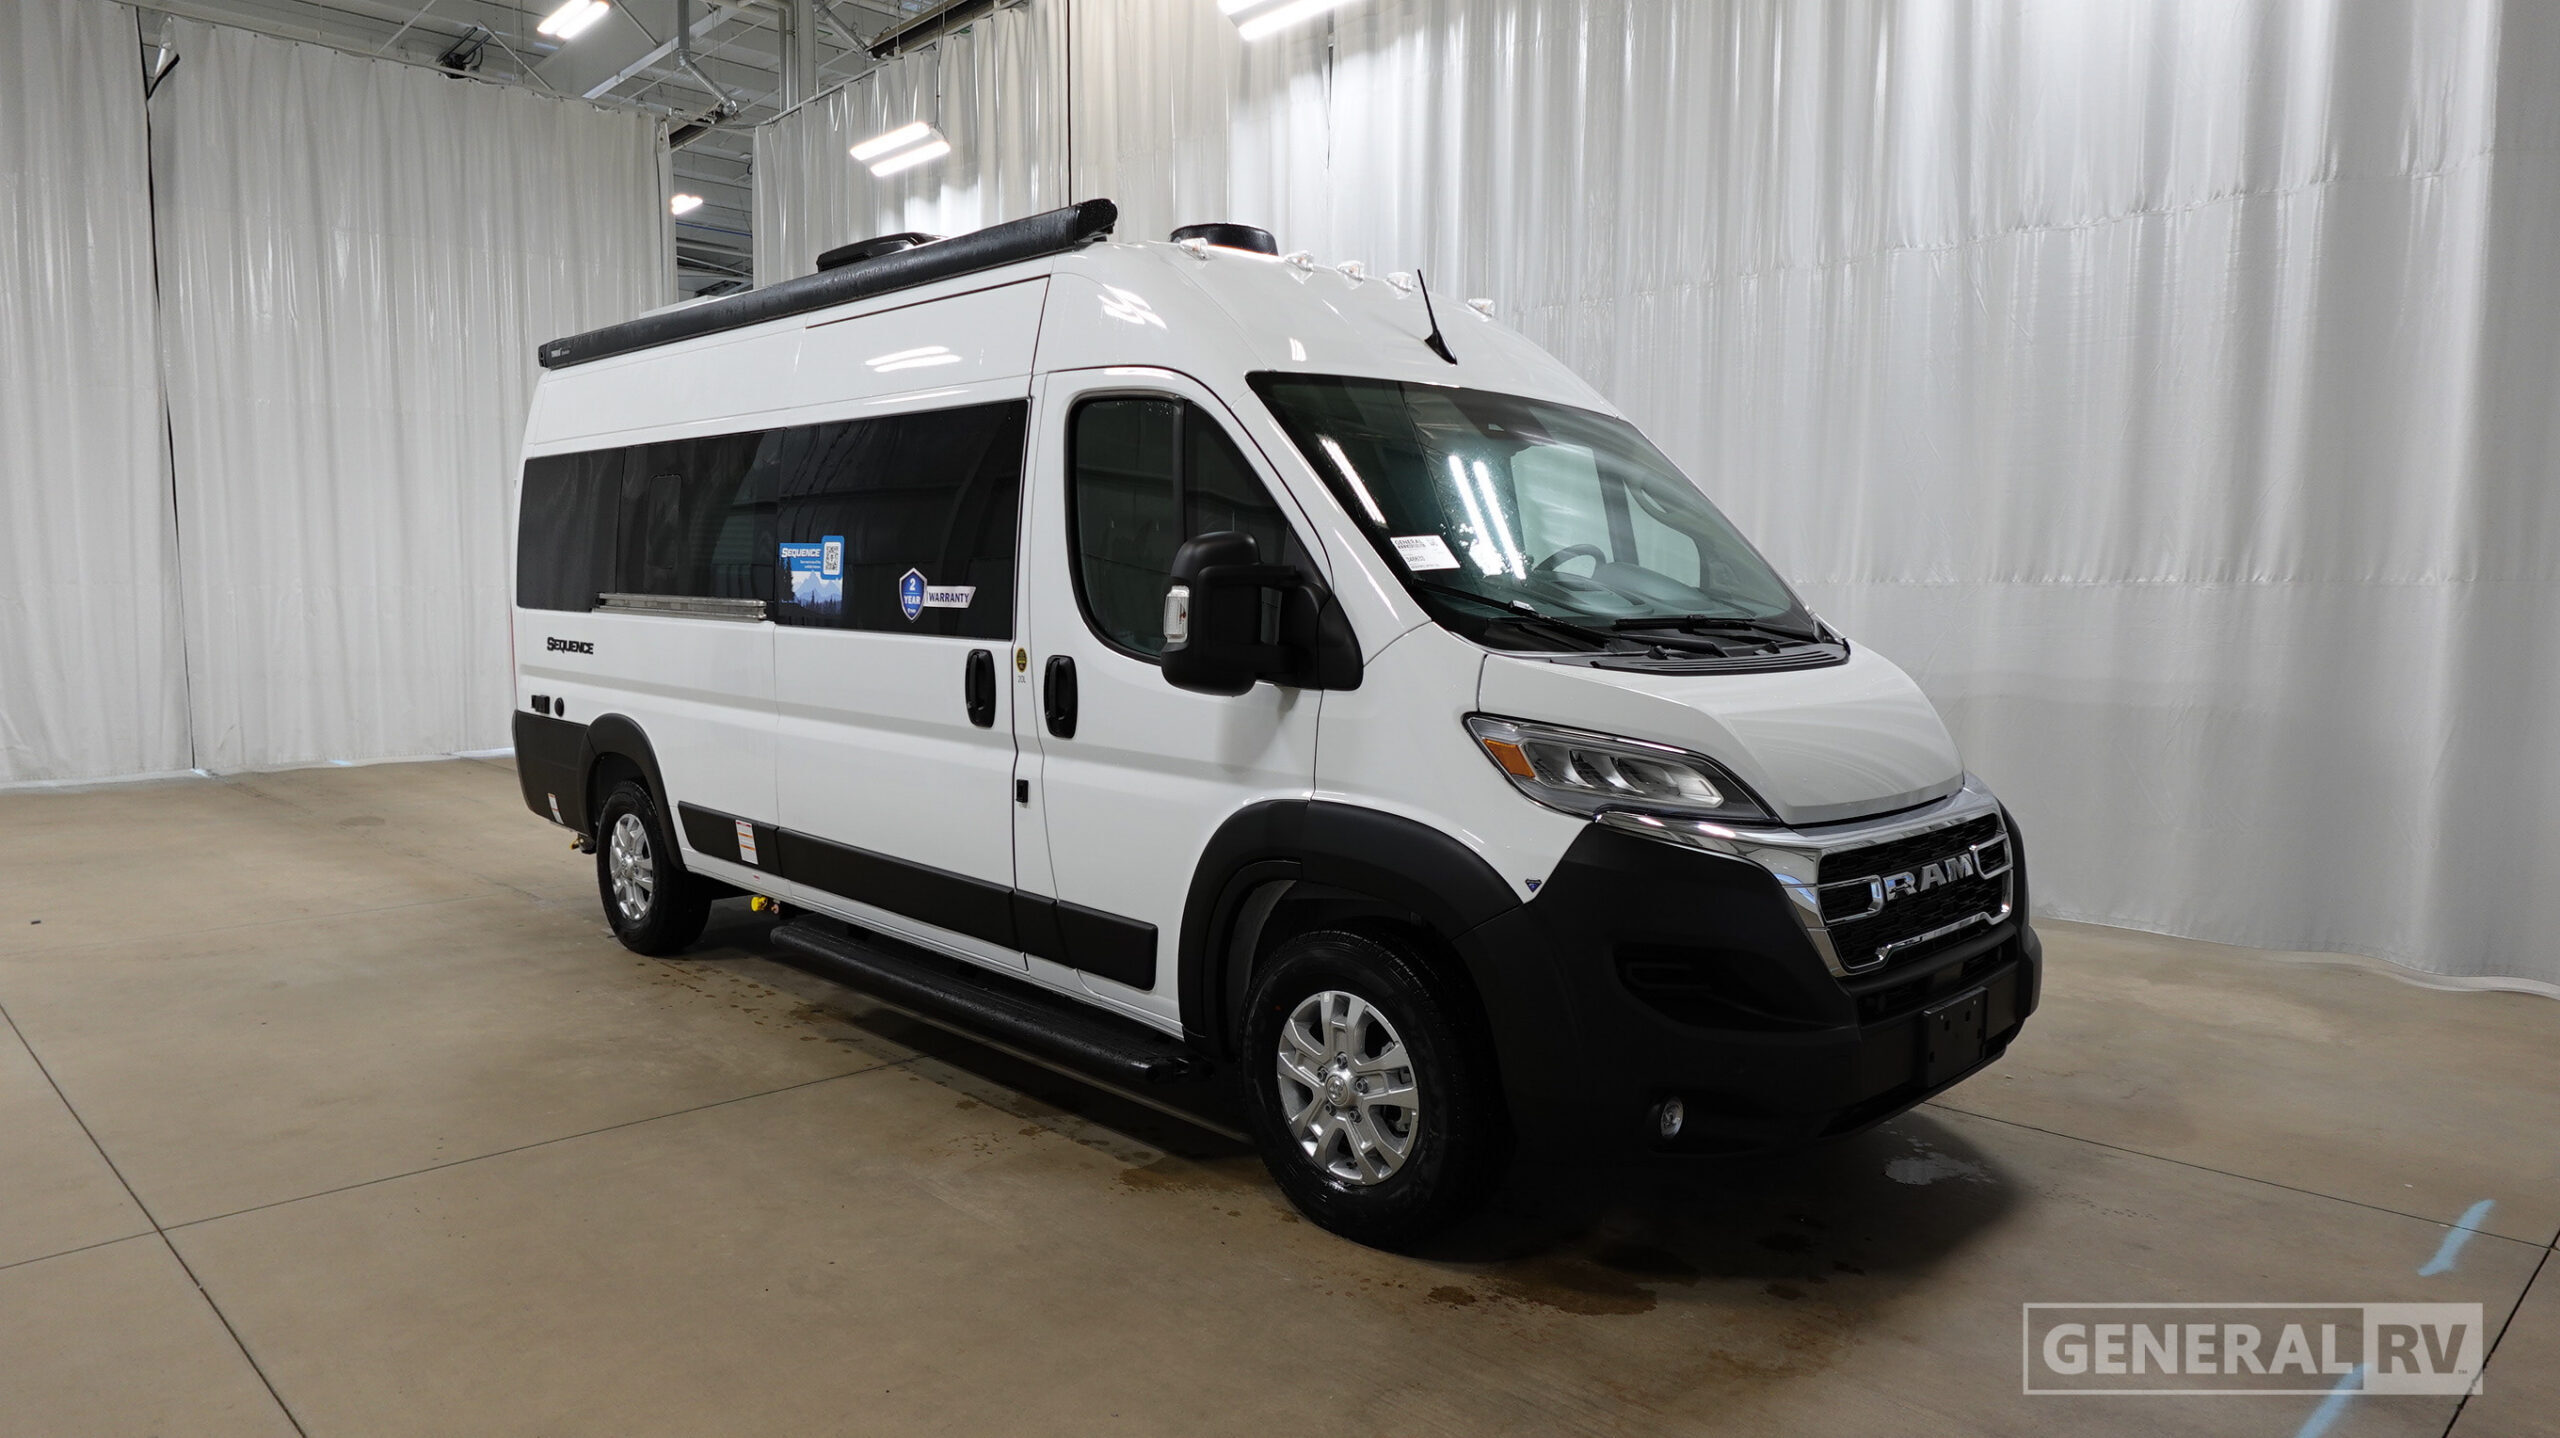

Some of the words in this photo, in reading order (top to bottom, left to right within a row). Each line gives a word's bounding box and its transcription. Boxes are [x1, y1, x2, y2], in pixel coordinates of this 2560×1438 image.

[781, 547, 821, 559] SEQUENCE
[909, 578, 916, 591] 2
[904, 595, 921, 605] YEAR
[928, 592, 970, 603] WARRANTY
[547, 637, 594, 655] SEQUENCE
[1882, 853, 1976, 901] RAM
